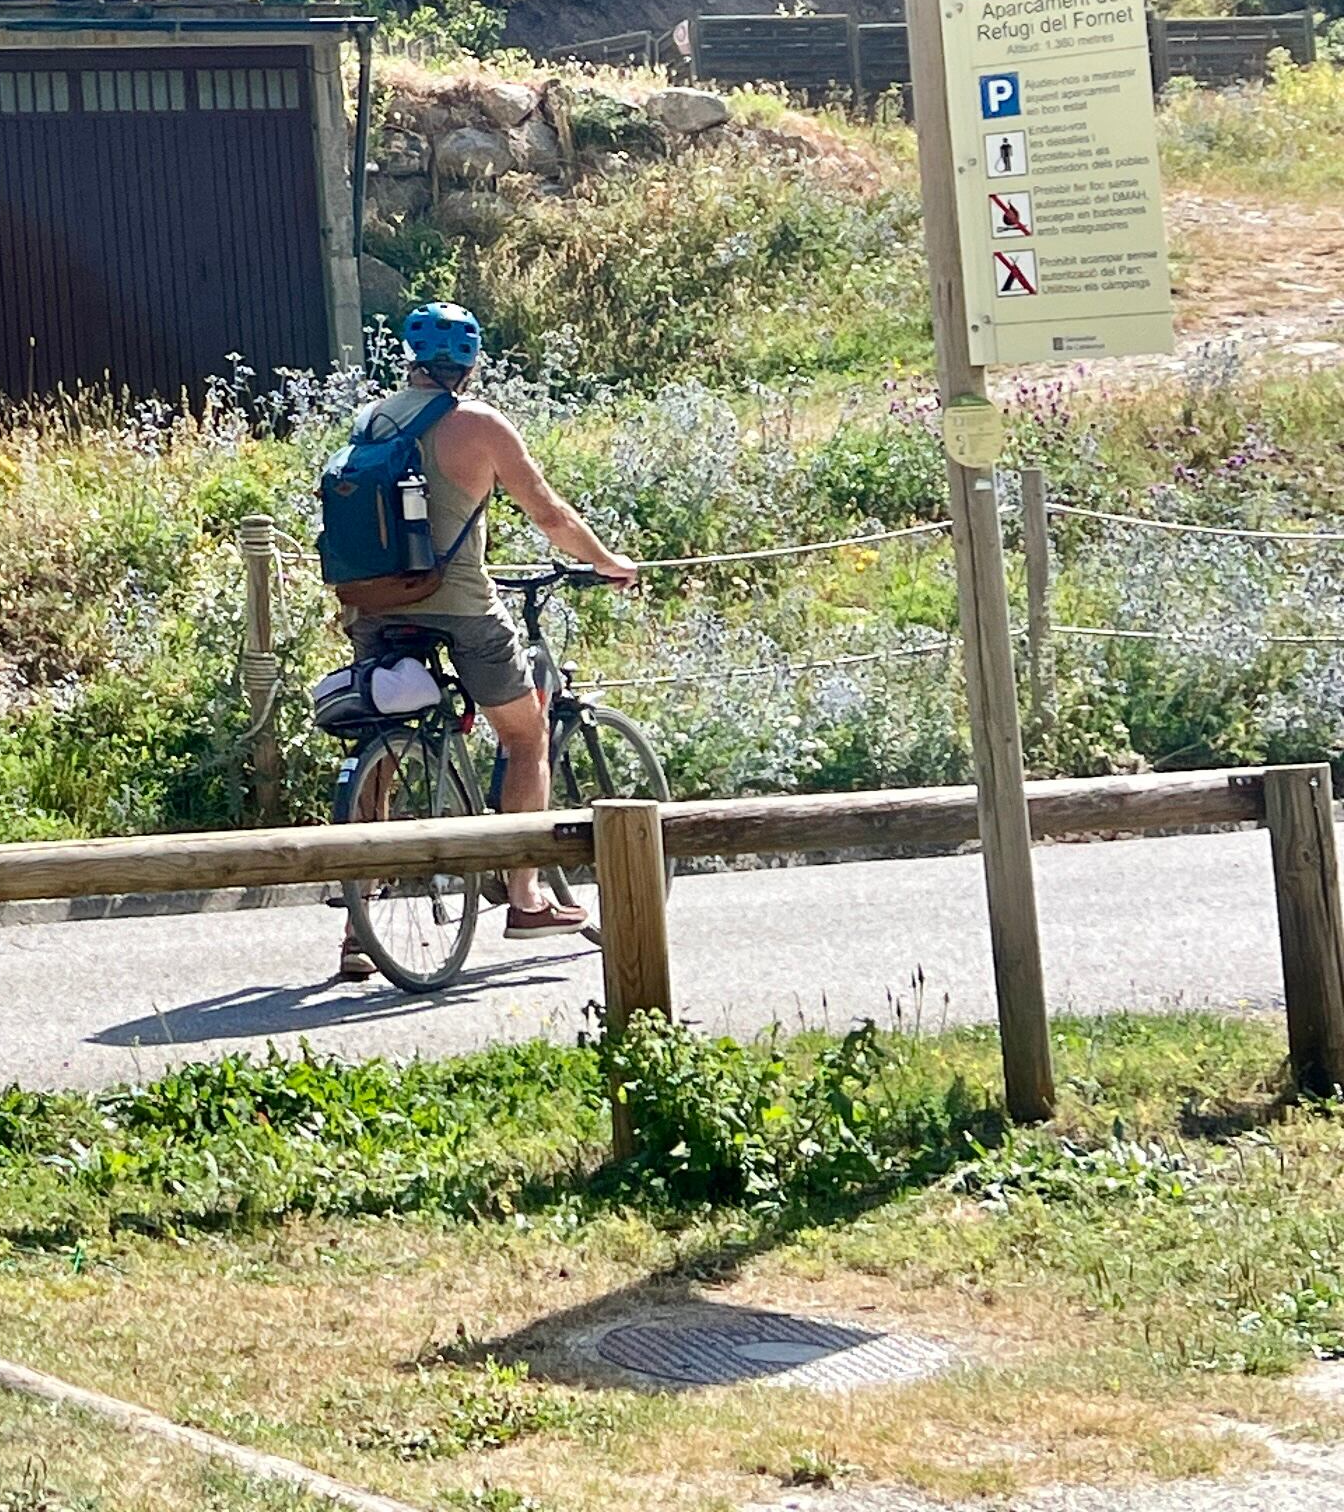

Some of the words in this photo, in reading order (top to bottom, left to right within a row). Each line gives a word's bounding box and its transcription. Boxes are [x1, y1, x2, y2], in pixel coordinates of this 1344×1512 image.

[977, 21, 1034, 41] Refugi
[1040, 16, 1067, 33] del
[1073, 7, 1134, 29] Fornet
[988, 79, 1013, 113] P
